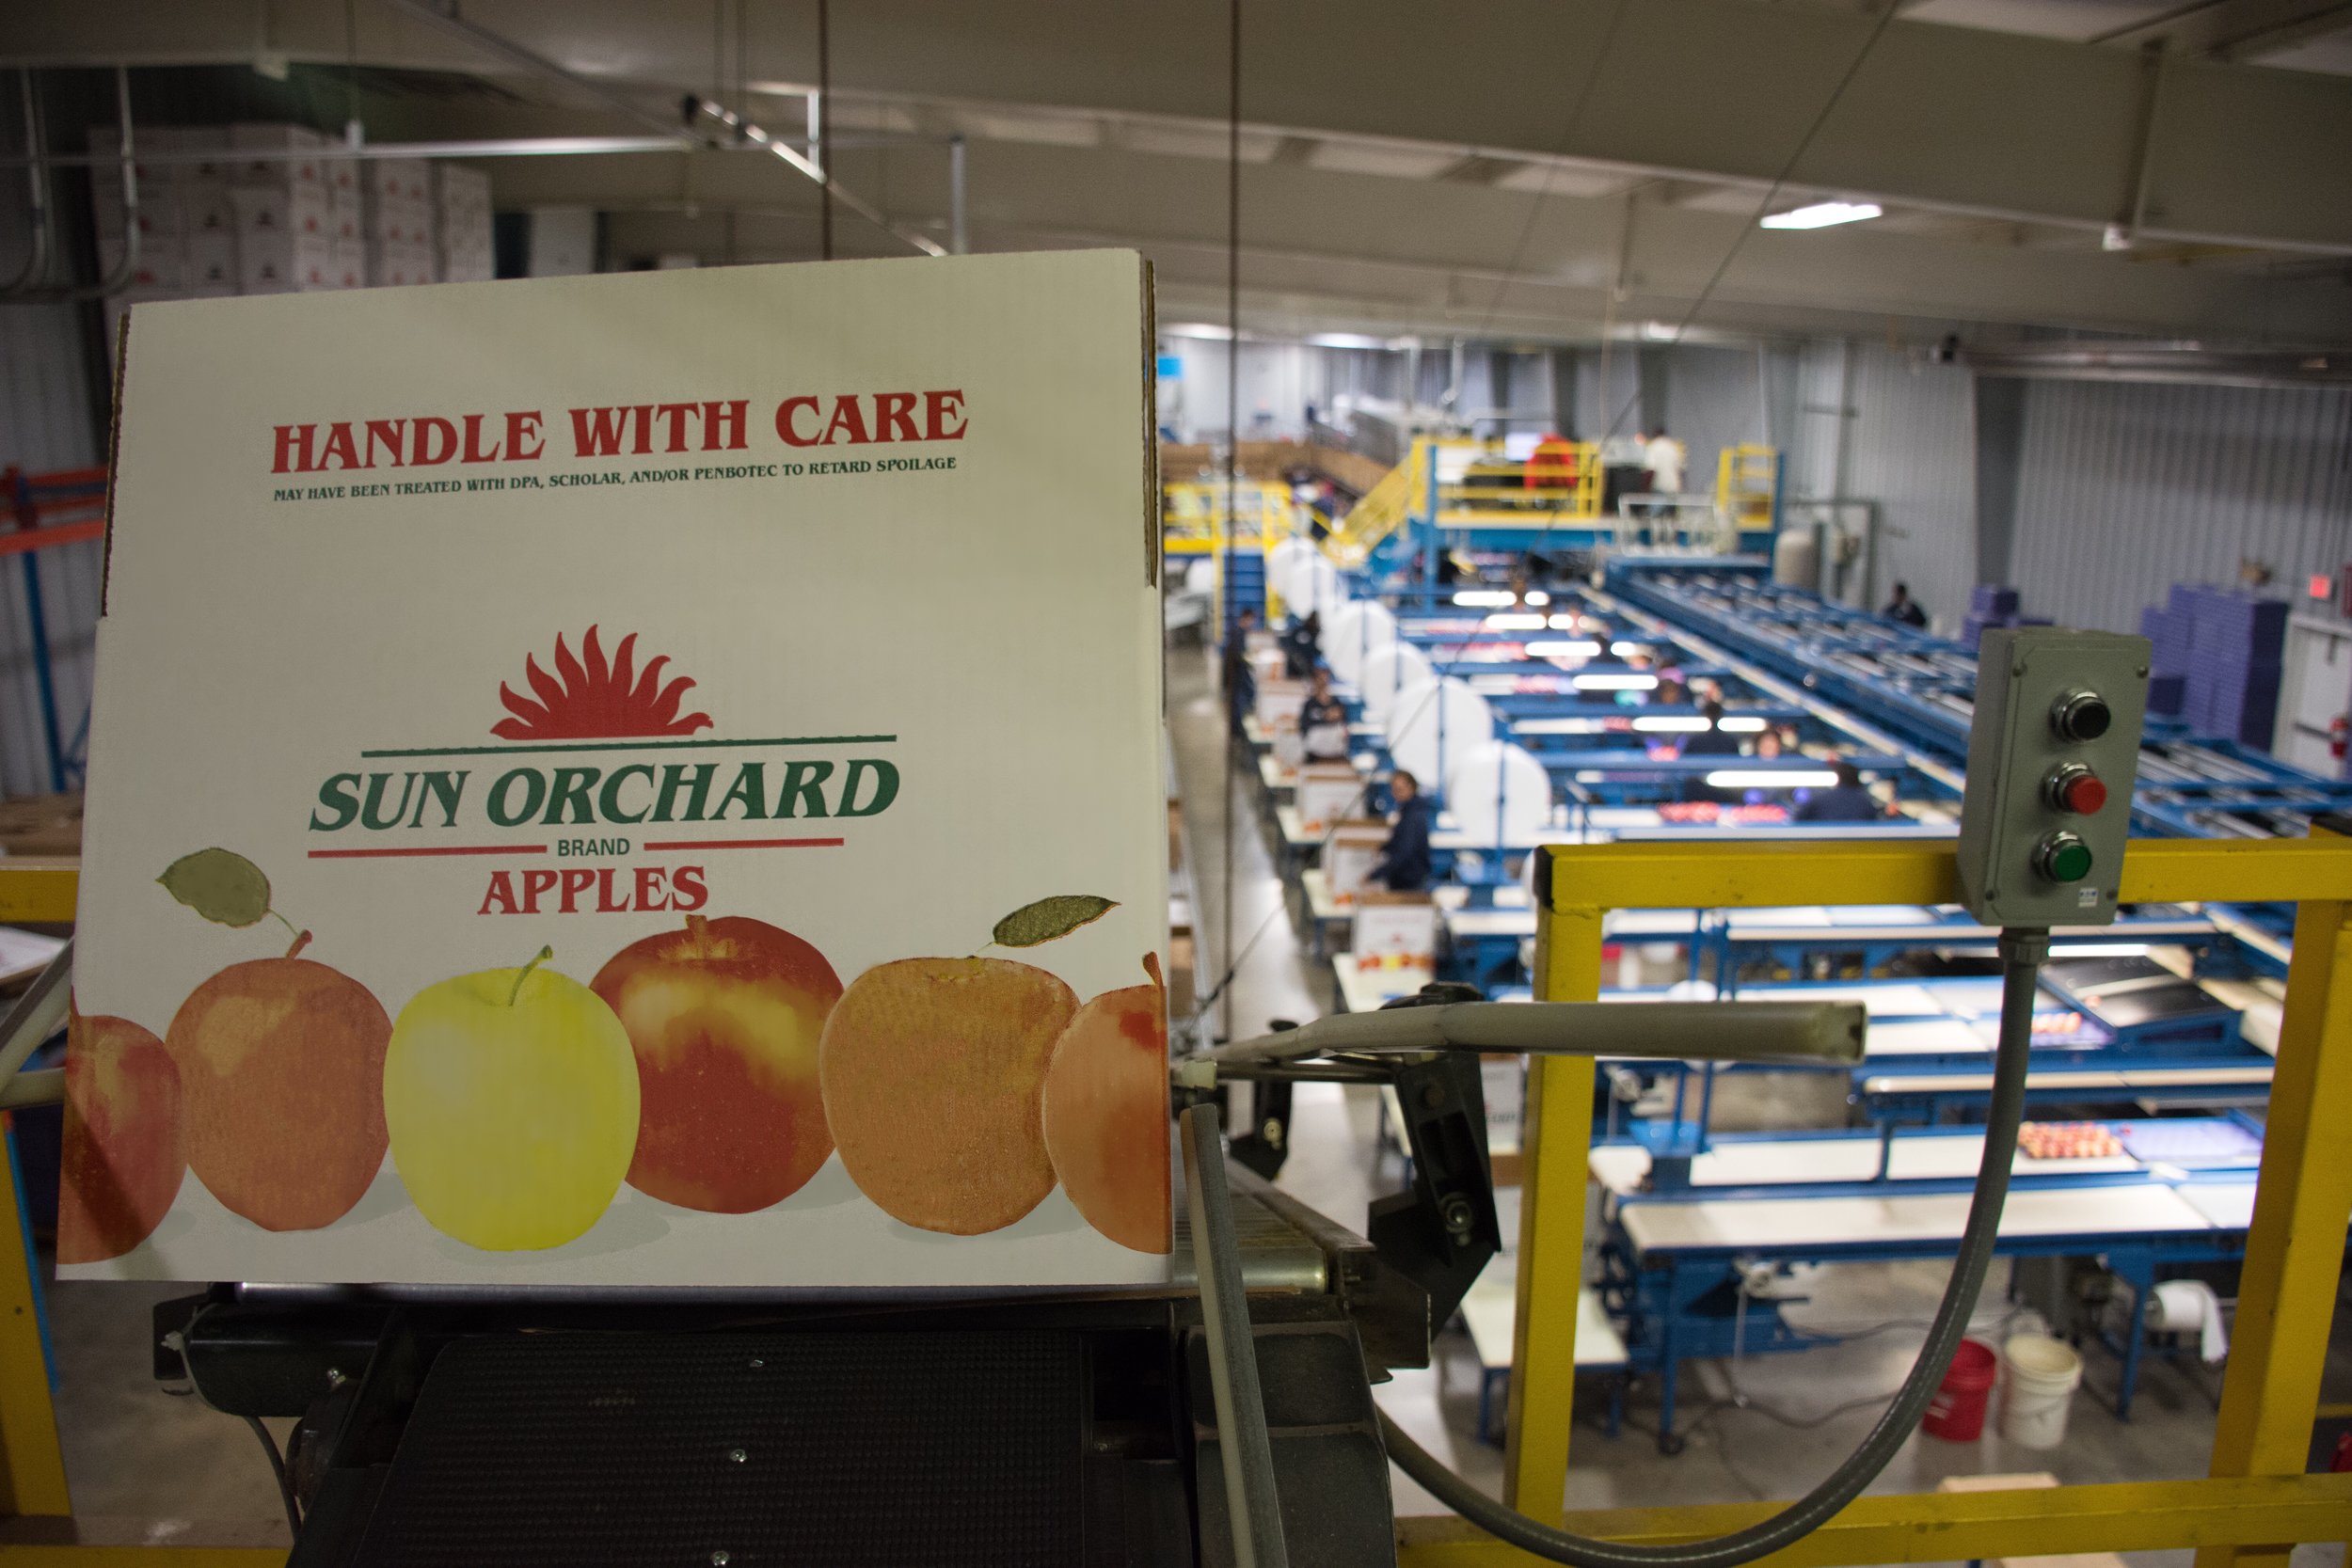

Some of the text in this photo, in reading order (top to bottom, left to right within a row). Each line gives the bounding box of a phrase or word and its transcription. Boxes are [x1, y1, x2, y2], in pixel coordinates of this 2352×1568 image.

[271, 388, 969, 473] HANDLE WITH CARE
[274, 457, 958, 501] MAY HAVE BEEN TREATED WITH DPA, SCHOLAR, AND/OR PENBOTEC TO RETARD SPOILAGE
[309, 758, 900, 832] SUN ORCHARD
[557, 837, 631, 857] BRAND
[477, 865, 709, 916] APPLES
